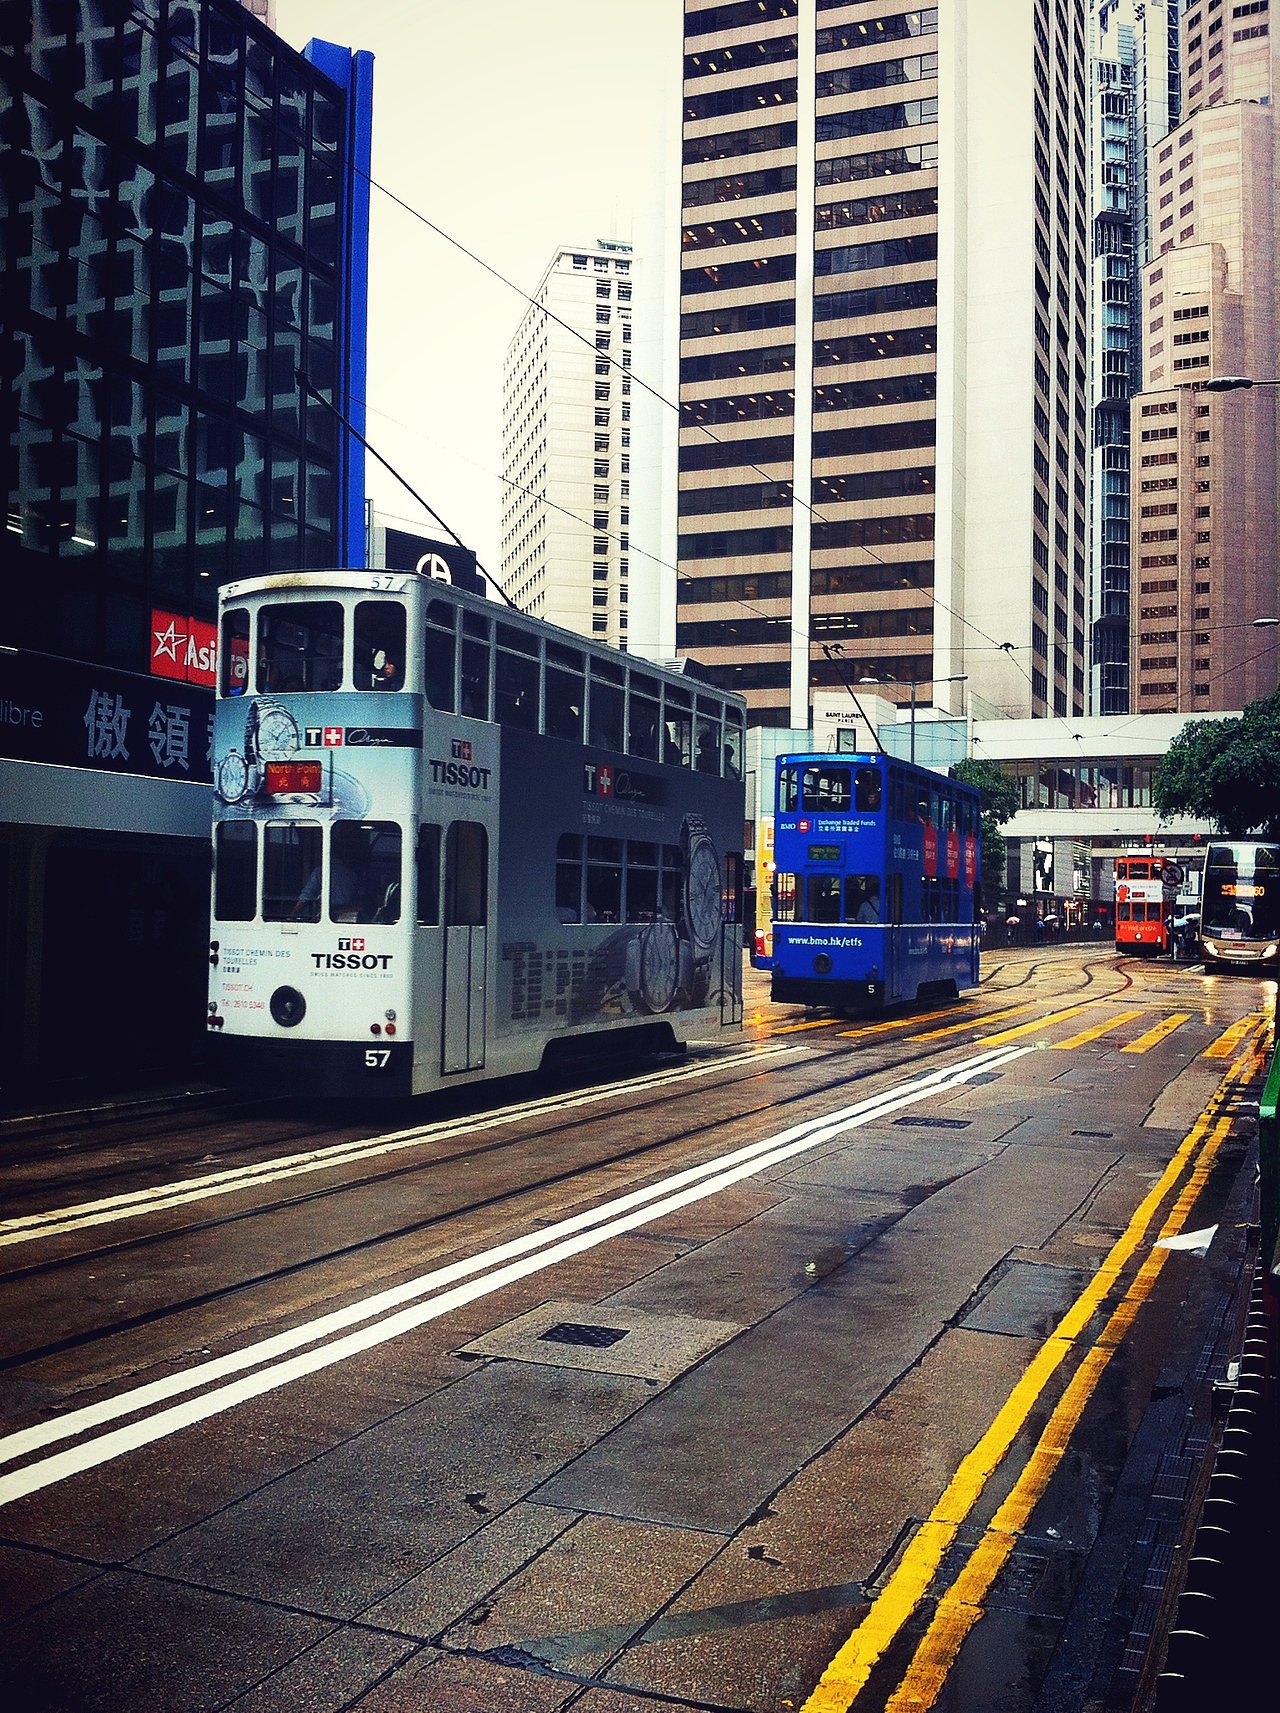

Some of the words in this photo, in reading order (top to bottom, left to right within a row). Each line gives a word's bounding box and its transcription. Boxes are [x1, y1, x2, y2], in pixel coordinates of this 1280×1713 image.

[370, 576, 394, 589] 57
[83, 687, 215, 775] 傲領
[780, 757, 787, 765] 5
[870, 755, 877, 764] 5
[429, 760, 491, 790] TISSOT
[817, 819, 841, 827] Exchange
[787, 936, 863, 948] www.bmo.hk/etfs
[274, 950, 291, 958] DES
[311, 953, 393, 970] TISSOT
[867, 984, 876, 994] 5
[364, 1049, 391, 1068] 57
